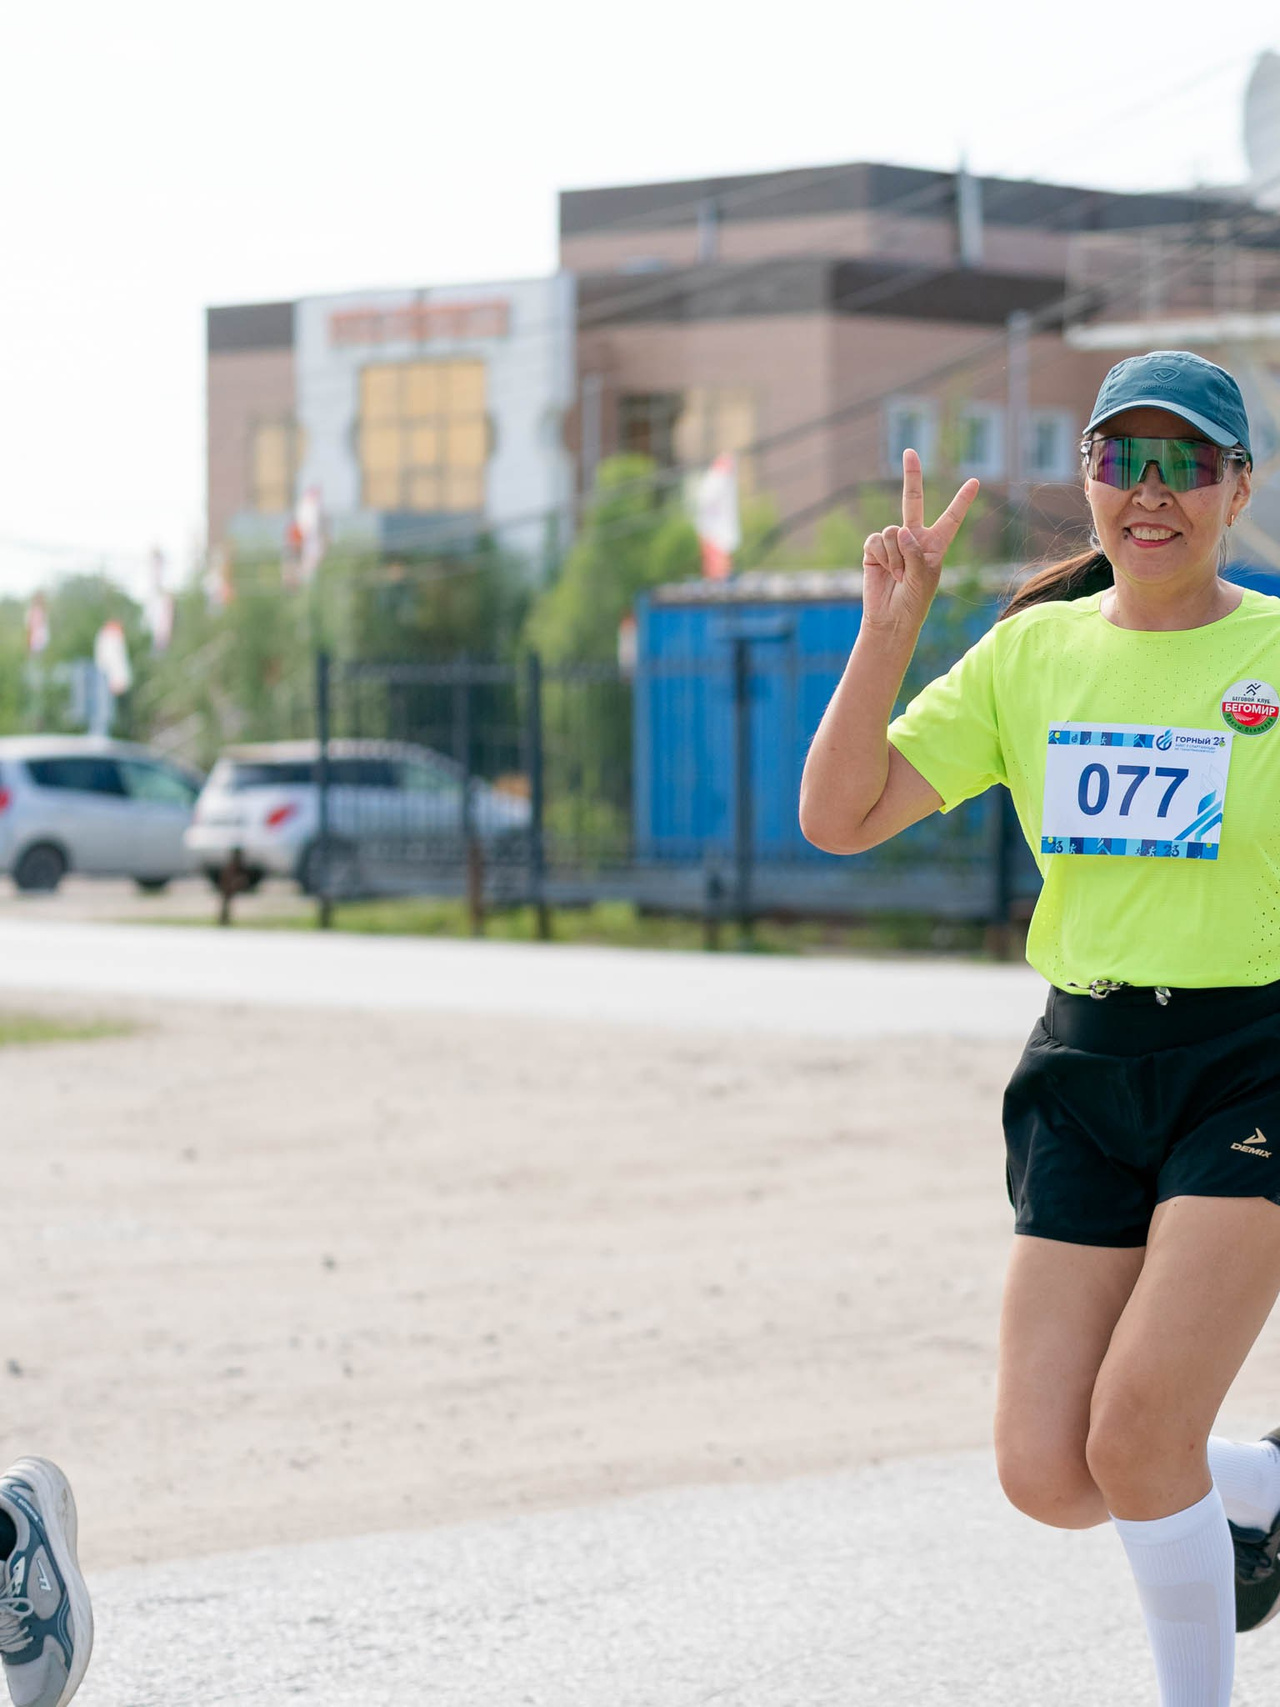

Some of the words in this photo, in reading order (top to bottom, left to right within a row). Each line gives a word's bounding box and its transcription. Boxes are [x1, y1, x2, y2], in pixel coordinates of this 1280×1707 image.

[1224, 702, 1276, 716] БЕГОМИР
[1175, 735, 1211, 745] ГОРНЫЙ
[1077, 762, 1189, 818] 077
[1230, 1142, 1272, 1158] DEMIX
